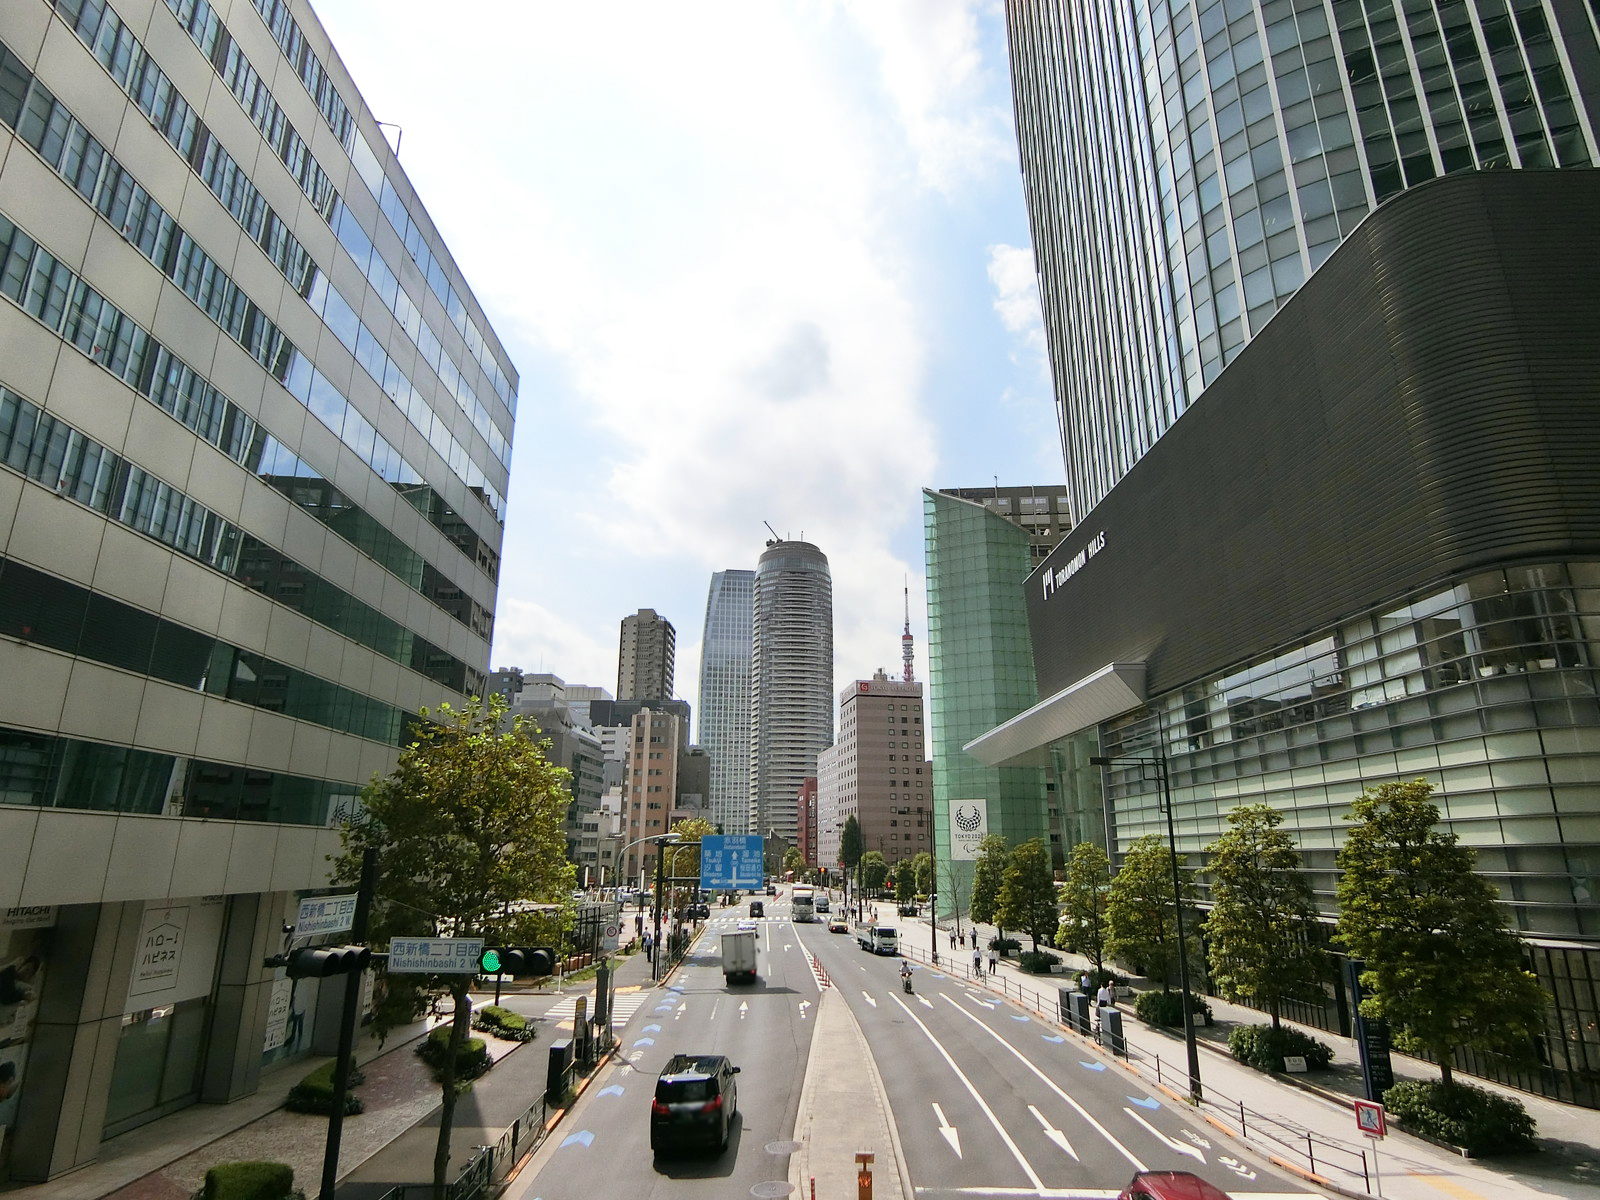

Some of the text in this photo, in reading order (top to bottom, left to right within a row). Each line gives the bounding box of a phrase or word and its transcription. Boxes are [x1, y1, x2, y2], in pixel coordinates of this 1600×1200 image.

[1055, 530, 1106, 589] TORANOMON HILLS
[7, 905, 51, 917] HITACHI
[300, 899, 355, 919] 西新橋二丁目西
[298, 917, 339, 933] Nishishinbashi
[338, 915, 345, 927] 2
[393, 942, 481, 956] 西新橋二丁目西
[393, 957, 457, 968] Nishishinbashi
[460, 958, 465, 968] 2
